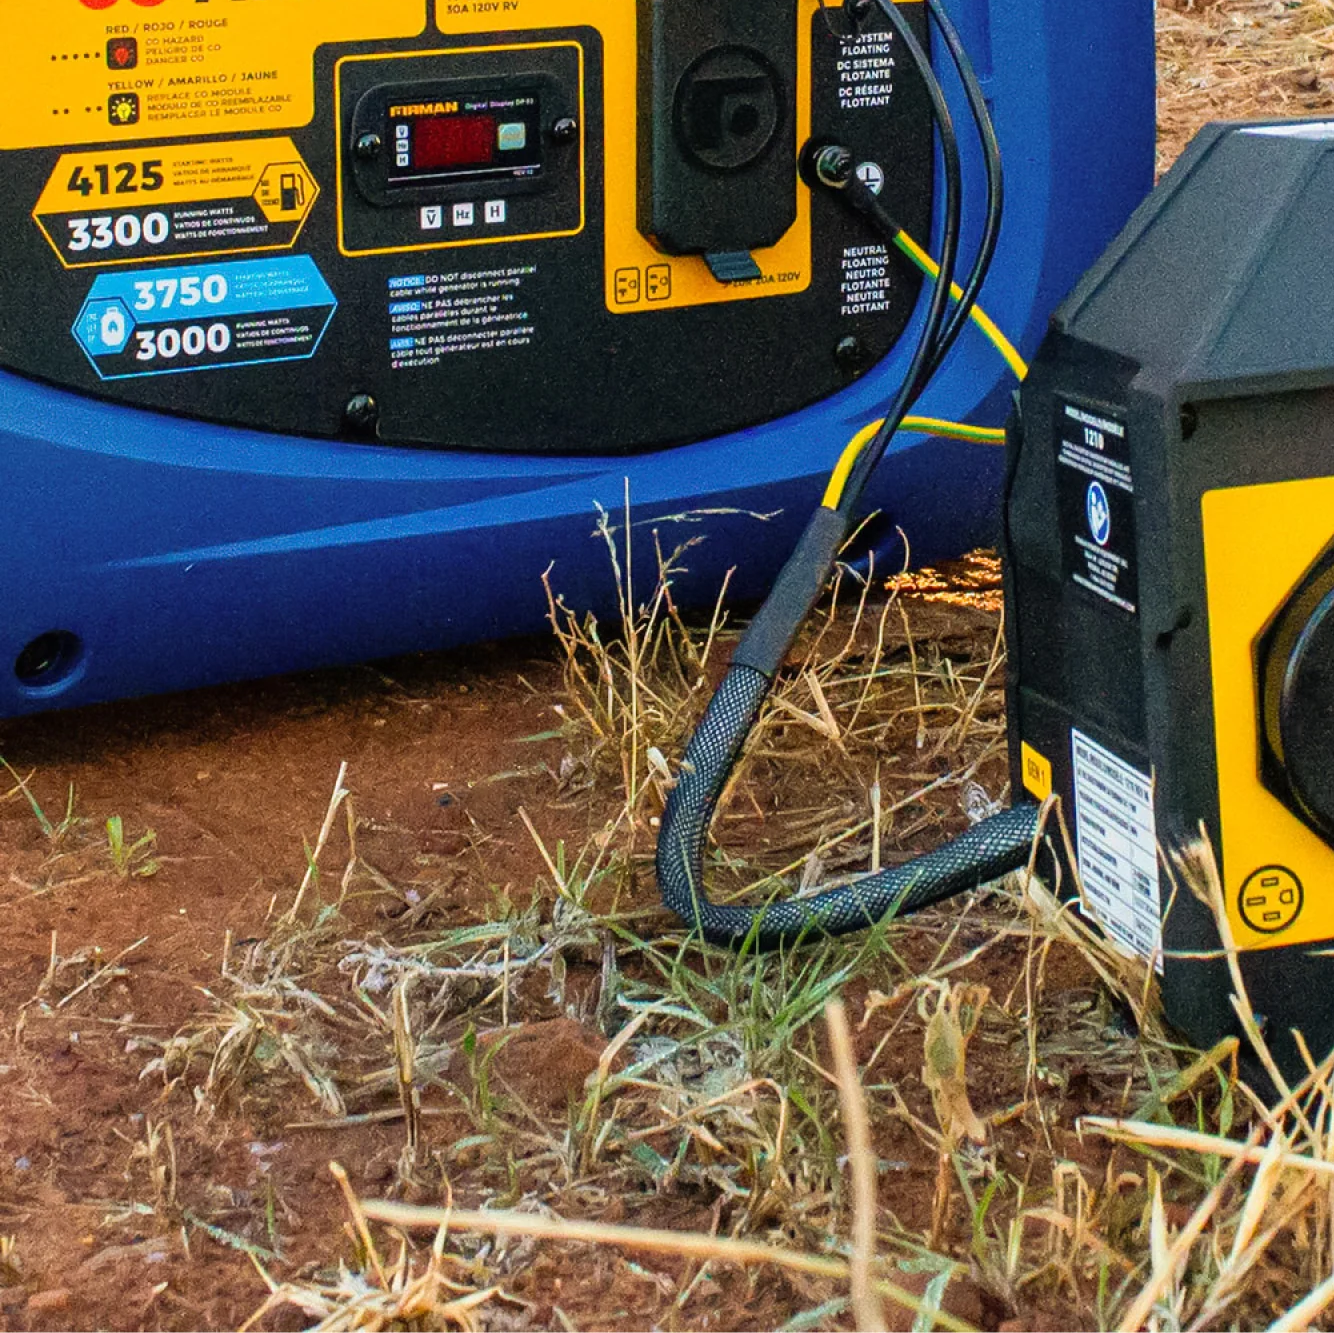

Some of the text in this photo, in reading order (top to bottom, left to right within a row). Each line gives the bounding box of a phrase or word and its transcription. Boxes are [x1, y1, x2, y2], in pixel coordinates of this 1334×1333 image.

[447, 0, 519, 15] 30A 120V RV
[105, 25, 129, 35] RED
[188, 17, 228, 29] ROUGE
[163, 35, 205, 45] HAZARD
[146, 46, 188, 56] PELIGRO
[191, 45, 203, 53] DE
[842, 43, 890, 56] FLOATING
[146, 56, 187, 65] DANGER
[836, 57, 895, 71] DC SISTEMA
[108, 69, 278, 91] YELLOW AMARILLO JAUNE
[841, 68, 891, 82] FLOTANTE
[147, 91, 190, 102] REPLACE
[211, 87, 252, 98] MODULE
[839, 83, 893, 97] DC RÉSEAU
[389, 101, 460, 118] FIRMAN
[841, 95, 890, 109] FLOTTANT
[67, 158, 165, 198] 4125
[456, 209, 469, 220] Hz
[490, 205, 500, 218] H
[67, 211, 169, 251] 3300
[209, 207, 234, 216] WATTS
[843, 244, 888, 258] NEUTRAL
[841, 255, 890, 270] FLOATING
[777, 271, 800, 283] 120V
[845, 267, 886, 280] NEUTRO
[133, 273, 228, 311] 3750
[841, 277, 891, 293] FLOTANTE
[846, 289, 885, 303] NEUTRE
[841, 300, 891, 316] FLOTTANT
[135, 322, 231, 362] 3000
